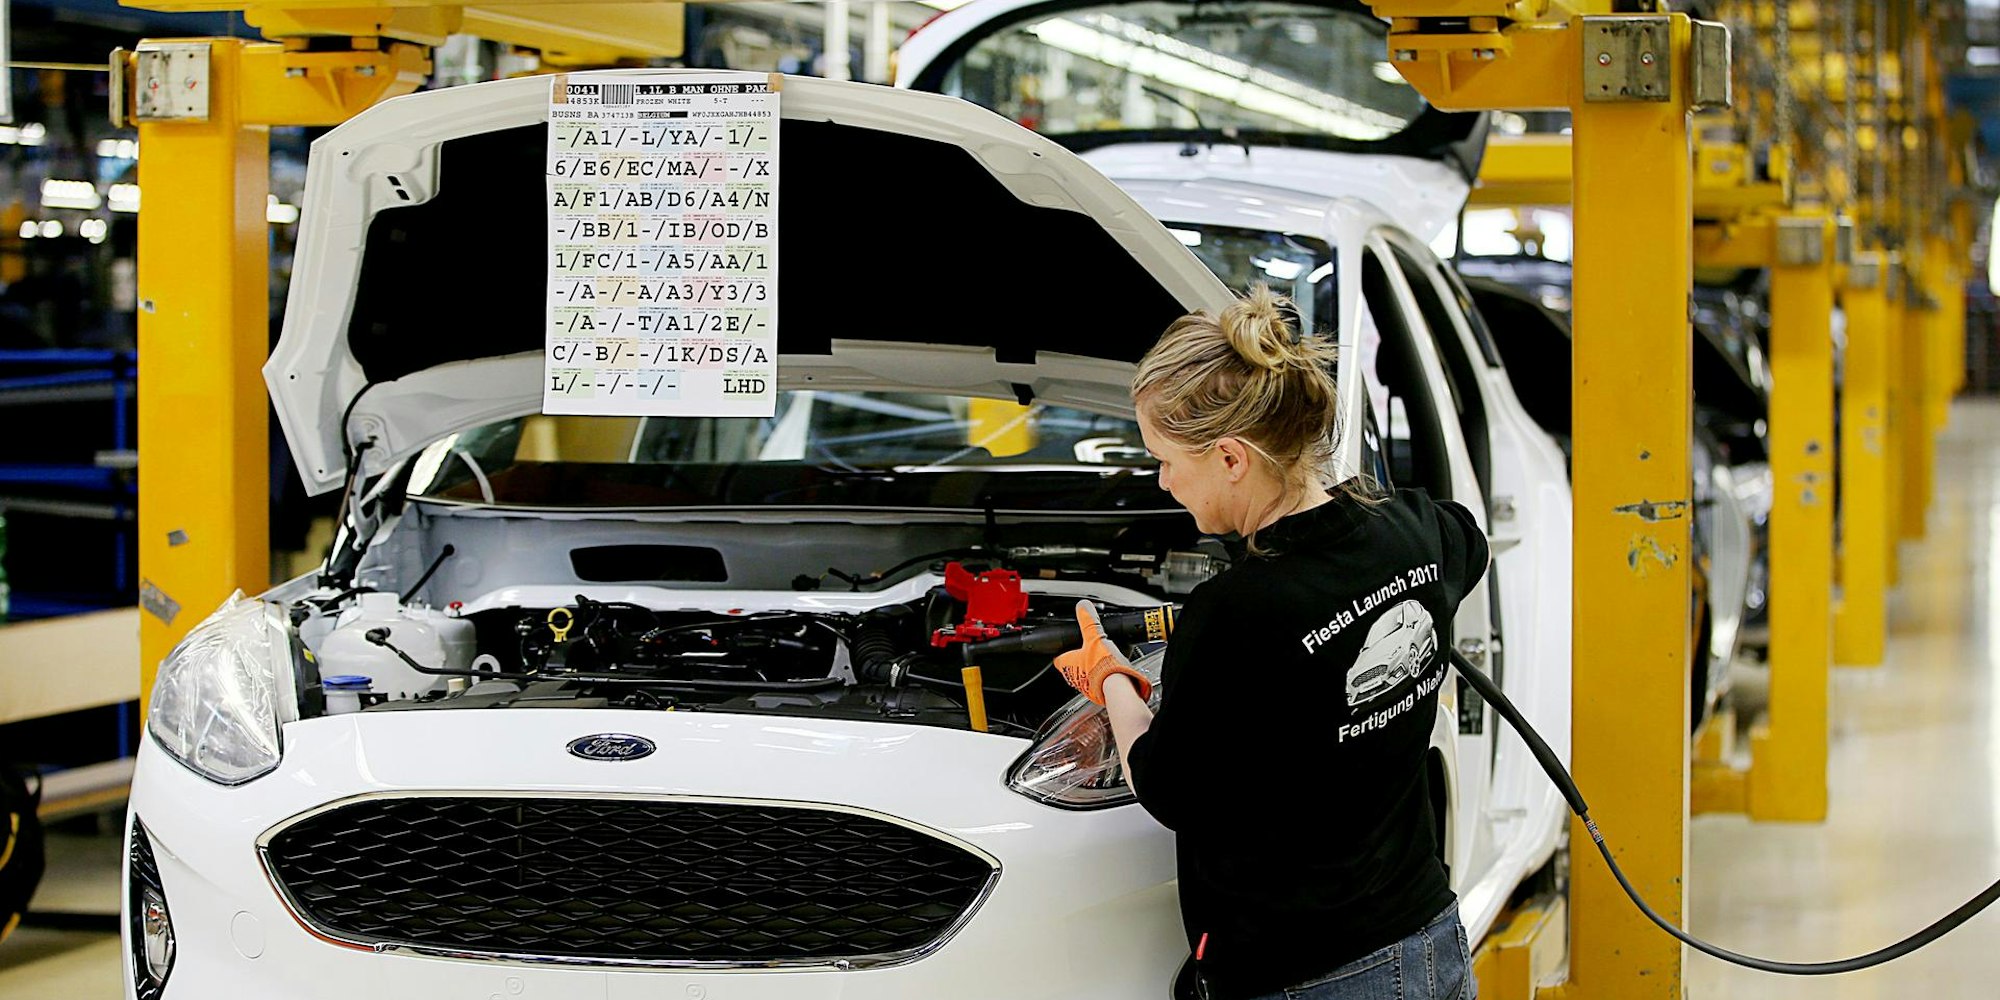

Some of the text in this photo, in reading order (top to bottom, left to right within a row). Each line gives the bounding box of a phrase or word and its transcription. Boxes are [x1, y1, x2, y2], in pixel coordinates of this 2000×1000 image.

[669, 85, 677, 94] B
[682, 85, 705, 94] MAN
[710, 85, 739, 93] OHNE
[552, 110, 582, 118] BUSNS
[724, 379, 764, 393] LHD
[1301, 563, 1439, 655] Fiesta Launch 2017
[1338, 693, 1414, 743] Fertigung
[584, 737, 637, 756] Ford
